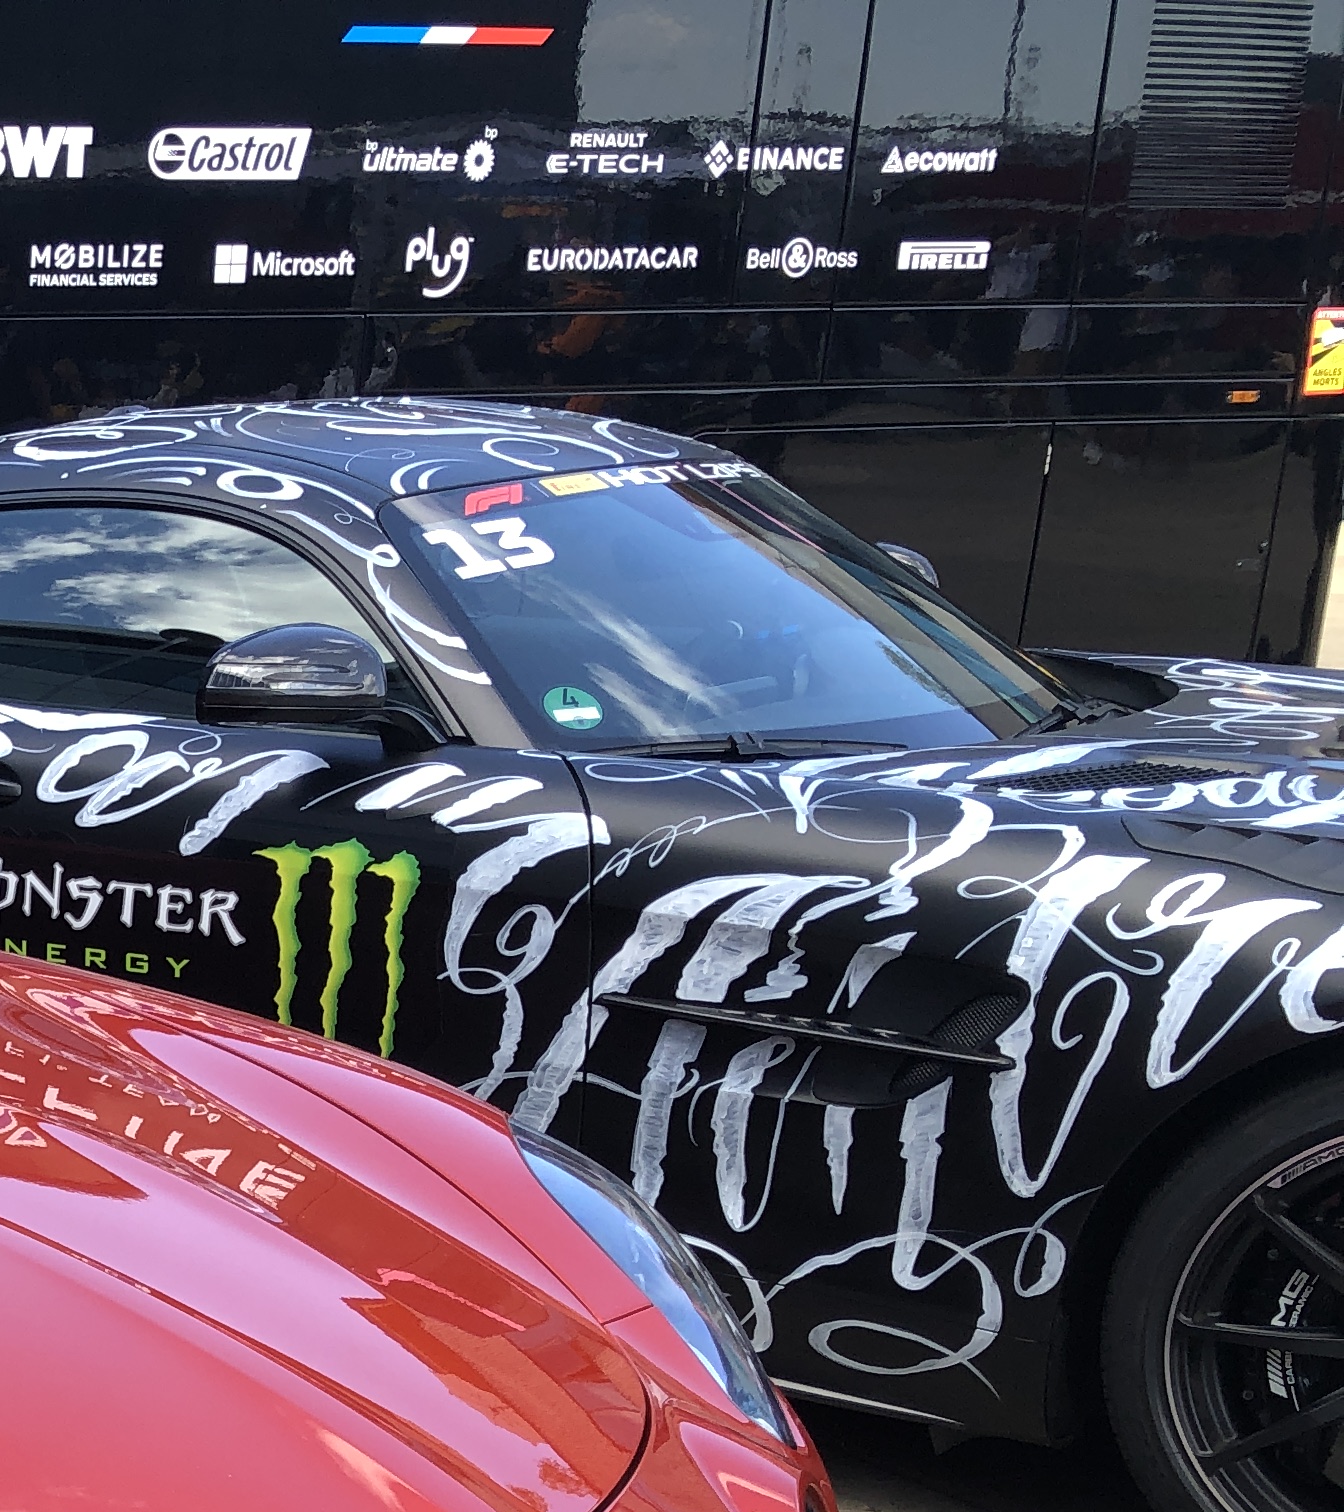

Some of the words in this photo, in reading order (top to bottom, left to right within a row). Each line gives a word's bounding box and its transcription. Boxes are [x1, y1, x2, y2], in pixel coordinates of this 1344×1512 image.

[484, 125, 498, 140] bp
[569, 133, 648, 149] RENAULT
[187, 135, 298, 172] Castrol
[365, 139, 379, 154] bp
[362, 147, 459, 173] ultimate
[545, 153, 664, 174] E-TECH
[904, 147, 999, 172] ecowatt
[251, 250, 355, 277] Microsoft
[405, 226, 470, 298] plug
[526, 246, 699, 271] EURODATACAR
[746, 248, 780, 270] Bell
[814, 248, 858, 269] Ross
[897, 240, 991, 270] PIRELLI
[29, 273, 97, 287] FINANCIAL
[98, 272, 158, 286] SERVICES
[1313, 367, 1343, 377] ANGLES
[1313, 377, 1339, 386] MORTS
[597, 465, 688, 488] HOT
[422, 517, 555, 580] 13
